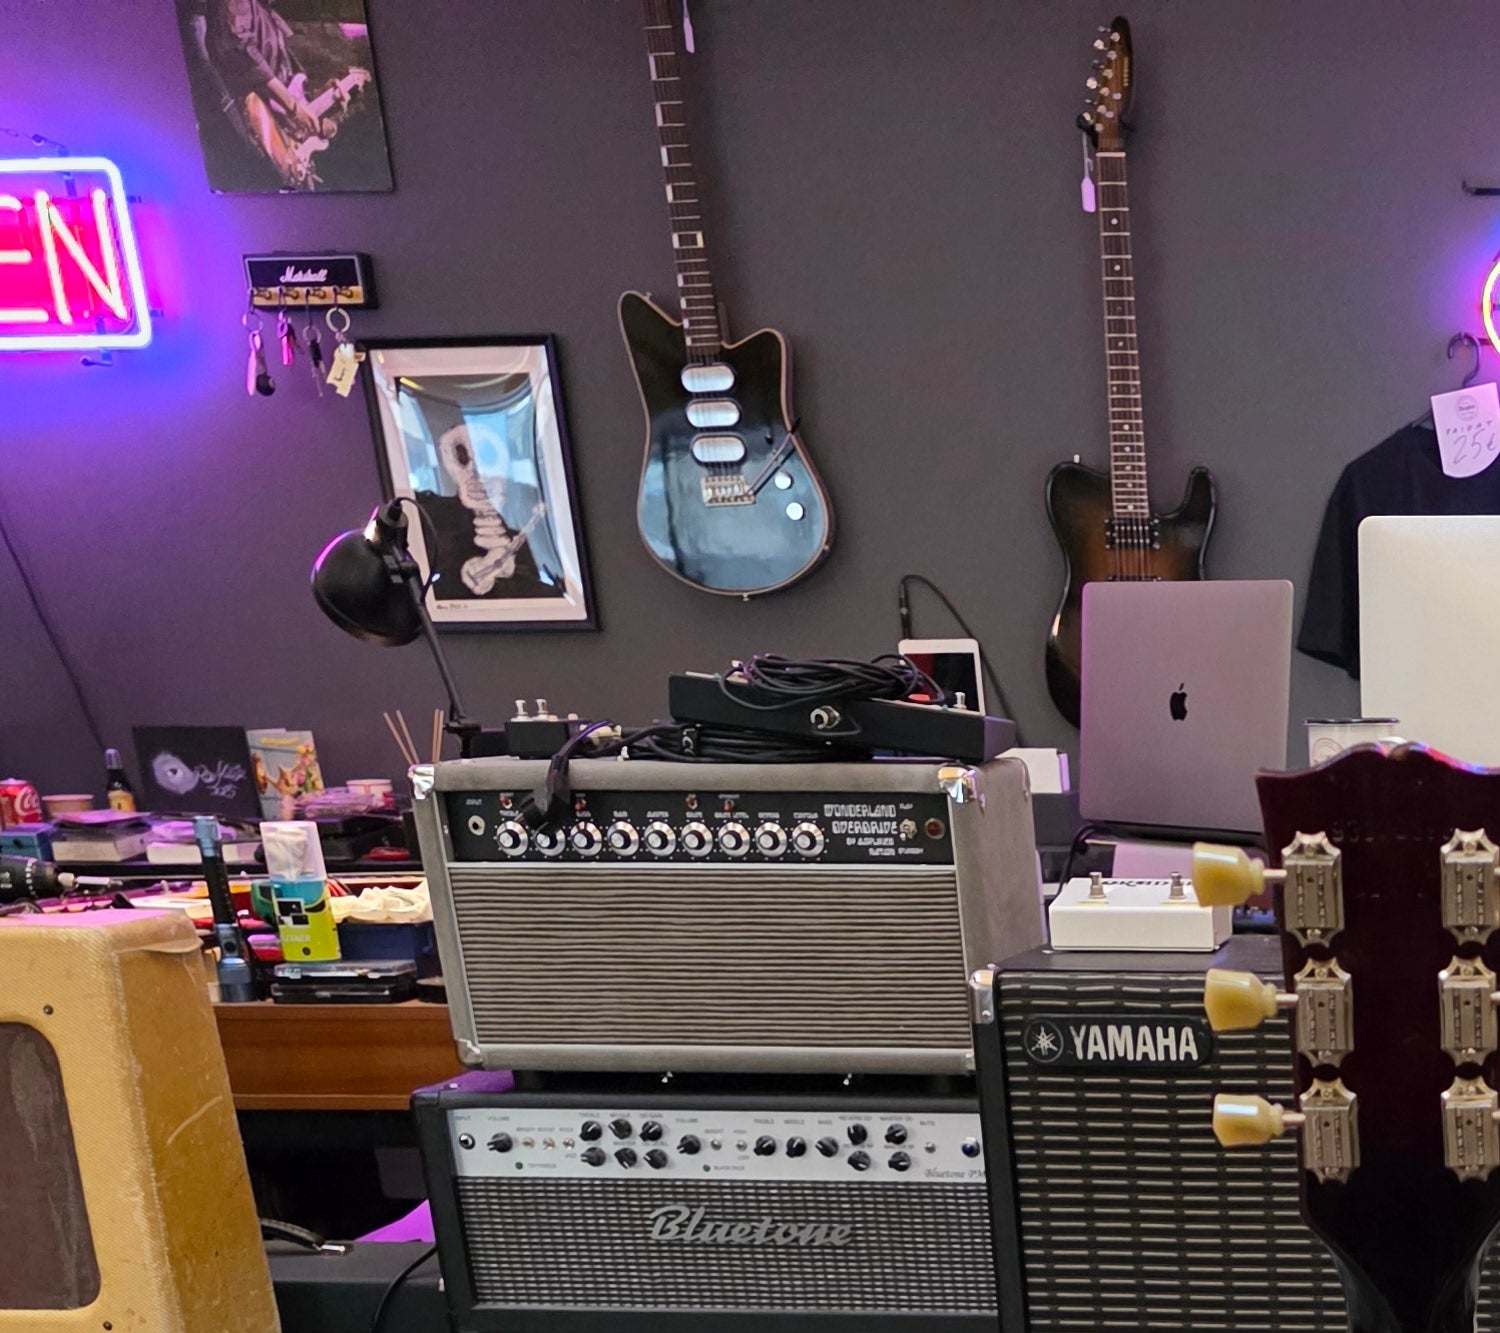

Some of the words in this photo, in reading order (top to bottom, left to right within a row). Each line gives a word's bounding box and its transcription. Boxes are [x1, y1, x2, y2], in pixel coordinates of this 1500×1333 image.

[823, 803, 897, 818] WONDERLAND
[831, 820, 898, 835] OVERDRIVE
[1069, 1024, 1199, 1061] YAMAHA
[649, 1205, 852, 1246] Bluetone
